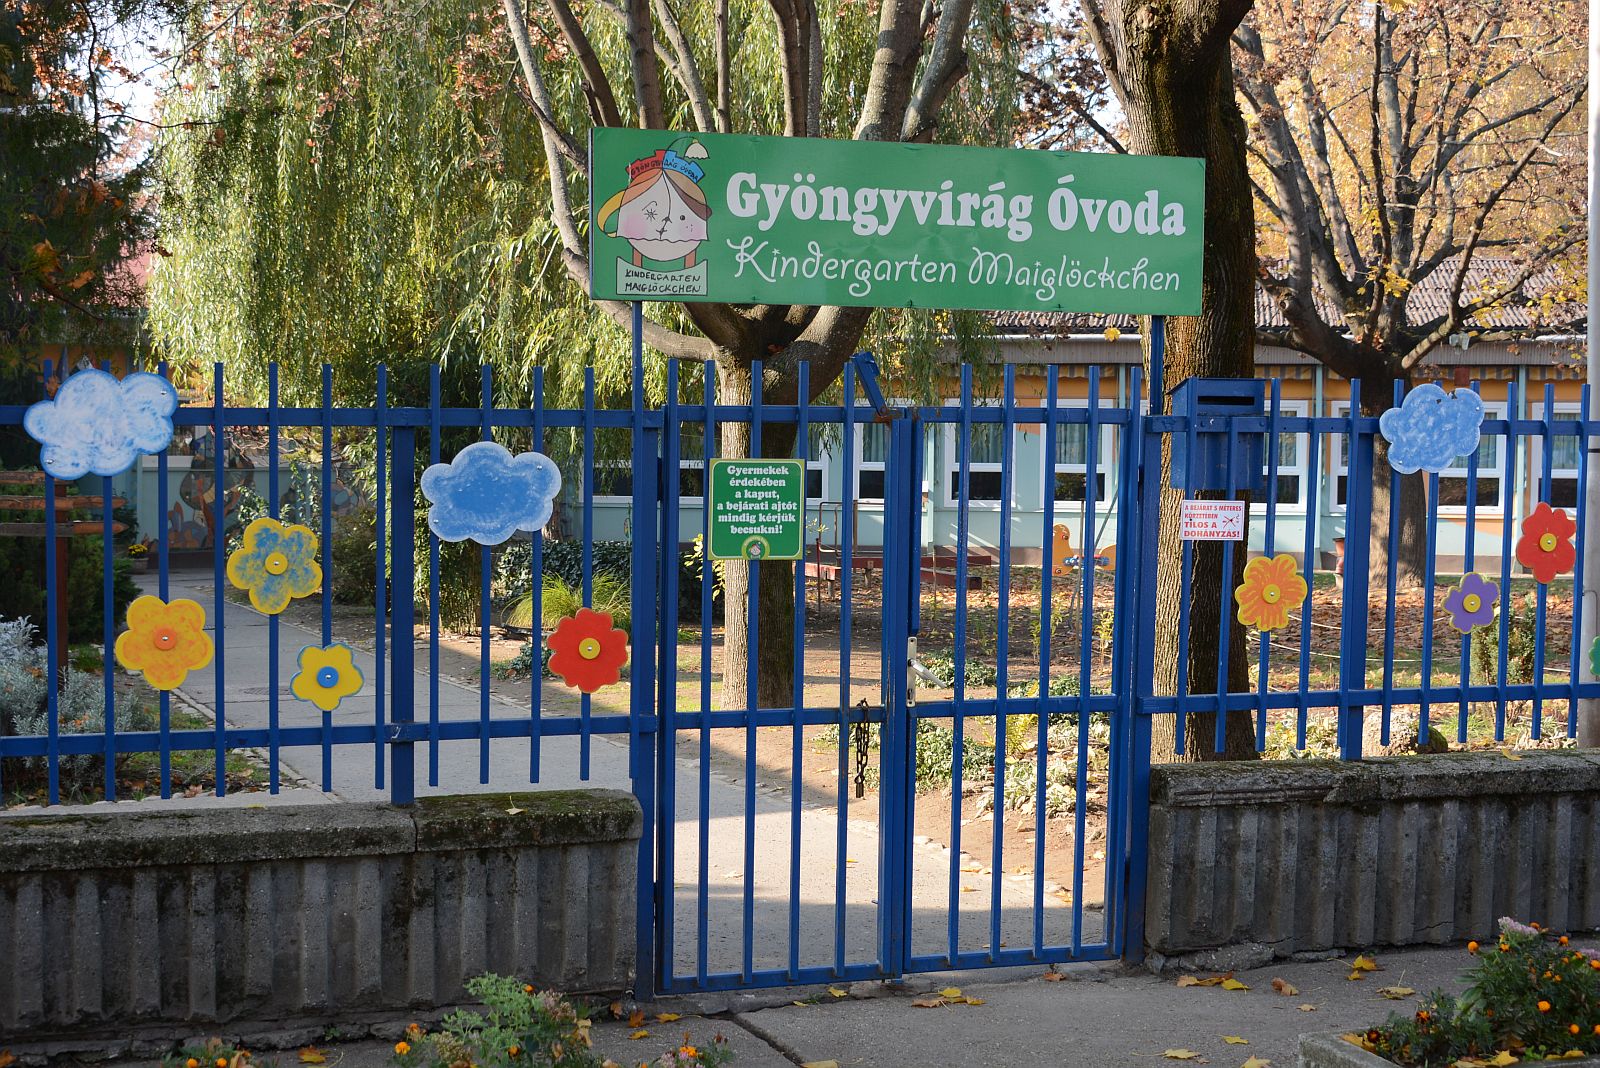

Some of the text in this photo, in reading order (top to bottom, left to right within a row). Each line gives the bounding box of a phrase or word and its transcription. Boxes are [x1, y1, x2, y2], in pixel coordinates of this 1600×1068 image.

[726, 172, 1186, 242] Gyöngyvirág Óvoda
[726, 236, 1180, 301] Kindergarten Maiglöckchen
[625, 268, 701, 282] KINDERGARTEN
[625, 282, 701, 293] MAIGLÖCKCHEN
[727, 465, 789, 476] Gyermekek
[729, 477, 786, 487] érdekében
[744, 489, 780, 500] kaput,
[726, 501, 769, 512] bejárati
[771, 502, 797, 512] ajtót
[718, 513, 796, 523] mindig kérjük
[730, 525, 783, 534] becsukni!
[1184, 529, 1240, 538] DOHÁNYZÁS!
